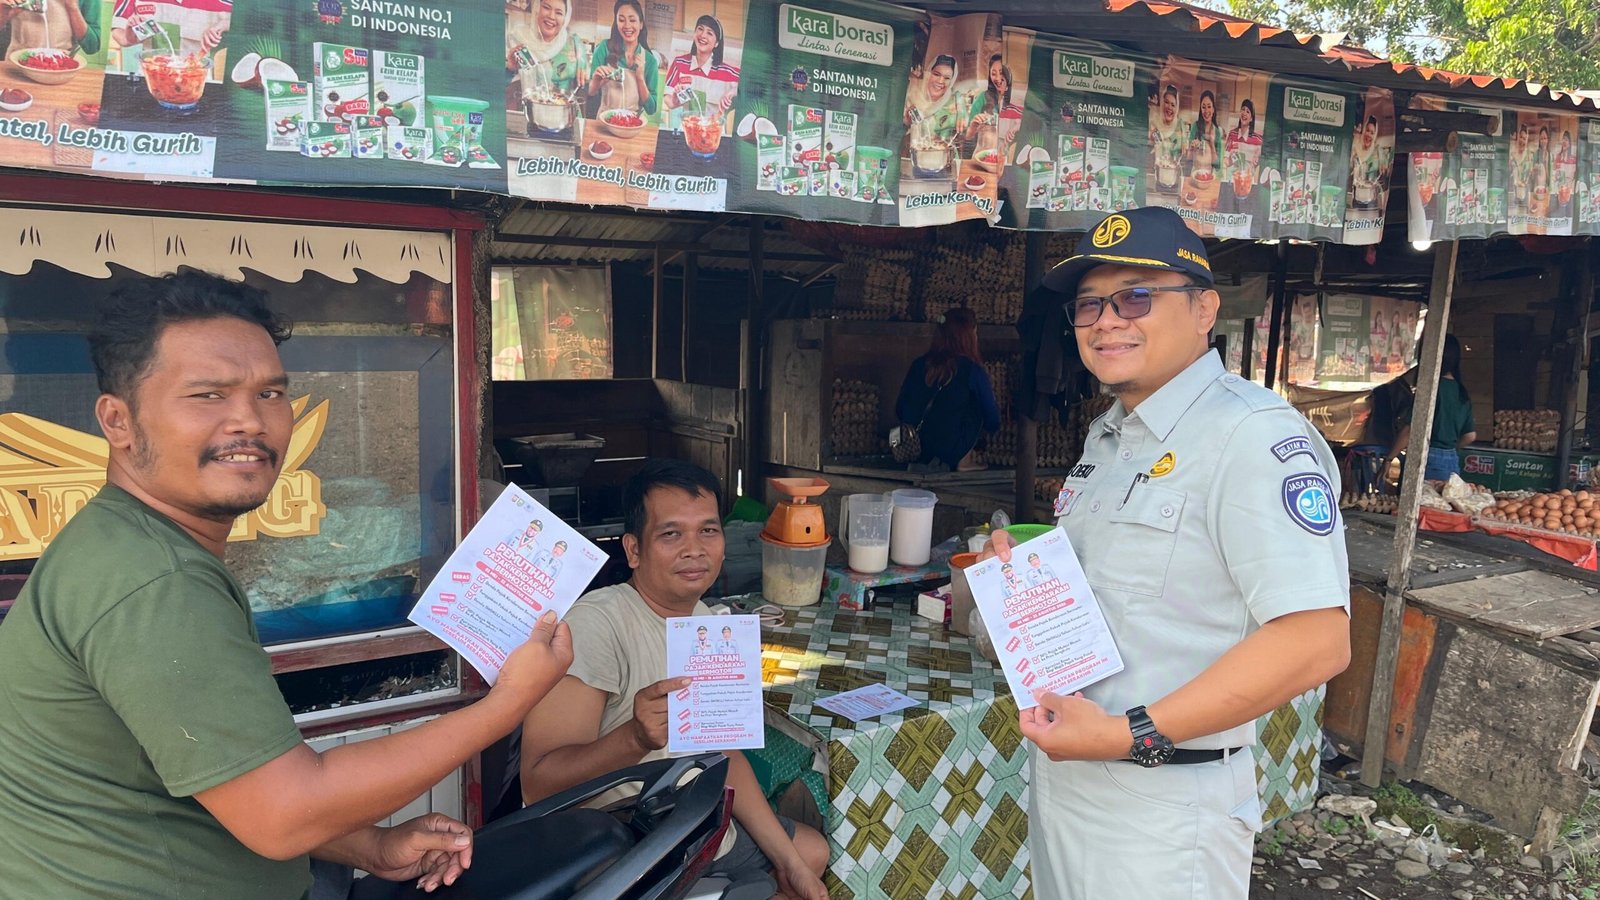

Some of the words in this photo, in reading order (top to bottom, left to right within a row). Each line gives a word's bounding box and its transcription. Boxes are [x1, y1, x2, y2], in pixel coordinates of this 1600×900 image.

[351, 0, 415, 18] SANTAN
[420, 7, 452, 24] NO.1
[352, 15, 367, 28] DI
[371, 18, 451, 40] INDONESIA
[792, 10, 829, 35] kara
[835, 22, 889, 46] borasi
[797, 36, 830, 53] Lintas
[834, 42, 878, 60] Generasi
[388, 53, 415, 67] kara
[1061, 55, 1089, 74] kara
[1093, 60, 1131, 81] borasi
[813, 68, 855, 85] SANTAN
[857, 77, 878, 89] NO.1
[813, 83, 823, 93] DI
[825, 85, 876, 101] INDONESIA
[1290, 91, 1311, 108] kara
[1314, 97, 1342, 113] borasi
[1078, 103, 1108, 115] SANTAN
[1109, 107, 1125, 117] NO.1
[1077, 115, 1085, 124] DI
[1086, 116, 1124, 128] INDONESIA
[59, 125, 125, 152] Lebih
[134, 134, 201, 153] Gurih
[1301, 132, 1322, 142] SANTAN
[518, 158, 564, 175] Lebih
[568, 159, 625, 186] Kental,
[629, 170, 670, 191] Lebih
[674, 177, 717, 192] Gurih
[906, 192, 944, 209] Lebih
[1205, 211, 1225, 225] Lebih
[1177, 247, 1192, 261] JASA
[1506, 459, 1544, 471] Santan
[1288, 480, 1306, 492] JASA
[483, 547, 511, 569] PAJAK
[507, 564, 553, 599] KENDARAAN
[495, 542, 554, 589] PEMUTIHAN
[494, 563, 534, 595] BERMOTOR
[1002, 602, 1027, 618] PAJAK
[1026, 582, 1069, 607] KENDARAAN
[1004, 577, 1060, 608] PEMUTIHAN
[1020, 596, 1057, 617] BERMOTOR
[690, 655, 738, 663] PEMUTIHAN
[1074, 660, 1101, 675] PROGRAM
